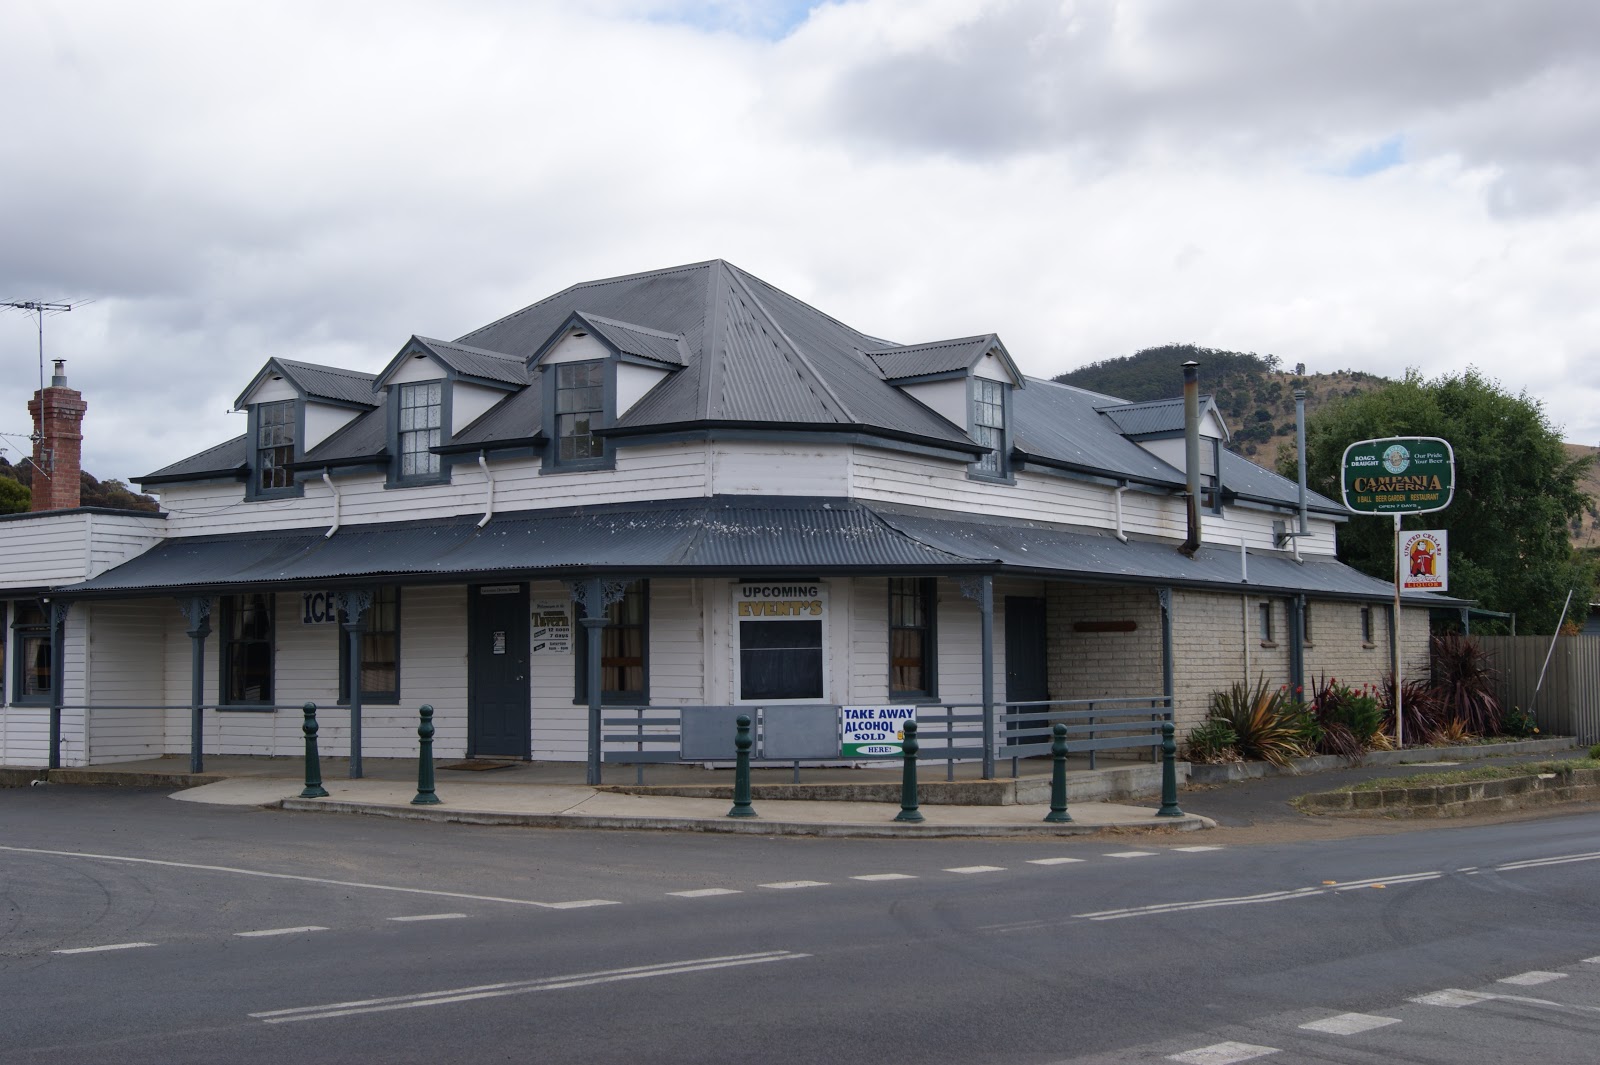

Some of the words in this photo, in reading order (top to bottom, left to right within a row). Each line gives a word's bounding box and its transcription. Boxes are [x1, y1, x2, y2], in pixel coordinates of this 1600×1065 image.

[1354, 474, 1442, 492] CAMPANIA
[1371, 483, 1425, 492] TAVERN
[1404, 534, 1420, 557] UNITED
[1423, 533, 1442, 556] CELLARS
[743, 586, 818, 597] UPCOMING
[303, 592, 335, 623] ICE
[738, 600, 823, 616] EVENT'S
[532, 613, 570, 627] Tavern
[844, 710, 874, 719] TAKE
[879, 709, 914, 718] AWAY
[844, 722, 894, 734] ALCOHOL
